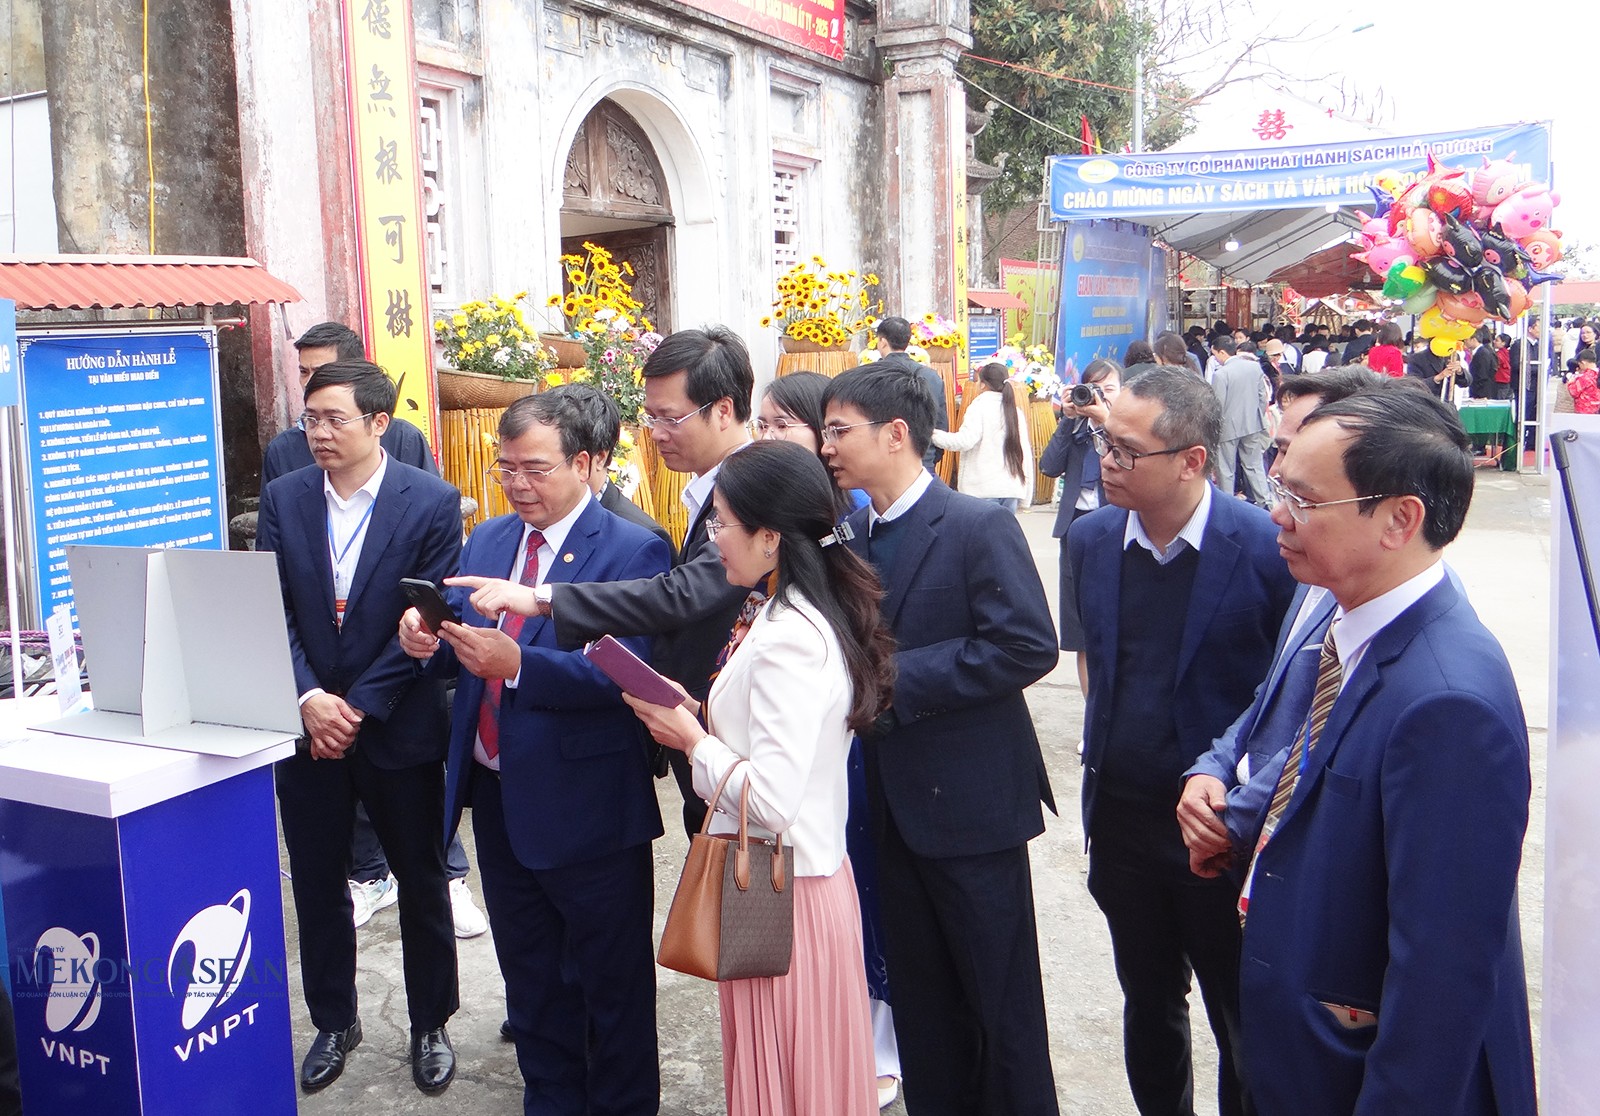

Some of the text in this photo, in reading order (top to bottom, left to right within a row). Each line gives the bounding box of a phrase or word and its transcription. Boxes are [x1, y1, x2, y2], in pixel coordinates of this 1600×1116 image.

[815, 17, 829, 39] 2025
[1124, 160, 1166, 178] CÔNG
[1167, 161, 1186, 176] TY
[1351, 143, 1396, 163] SÁCH
[1063, 188, 1107, 209] CHÀO
[1112, 186, 1164, 207] MỪNG
[1168, 182, 1215, 205] NGÀY
[1220, 179, 1266, 202] SÁCH
[1273, 176, 1297, 199] VÀ
[1302, 174, 1341, 197] VĂN
[66, 354, 105, 370] HƯỚNG
[132, 351, 162, 367] HÀNH
[174, 1002, 259, 1062] VNPT
[41, 1037, 111, 1075] VNPT
